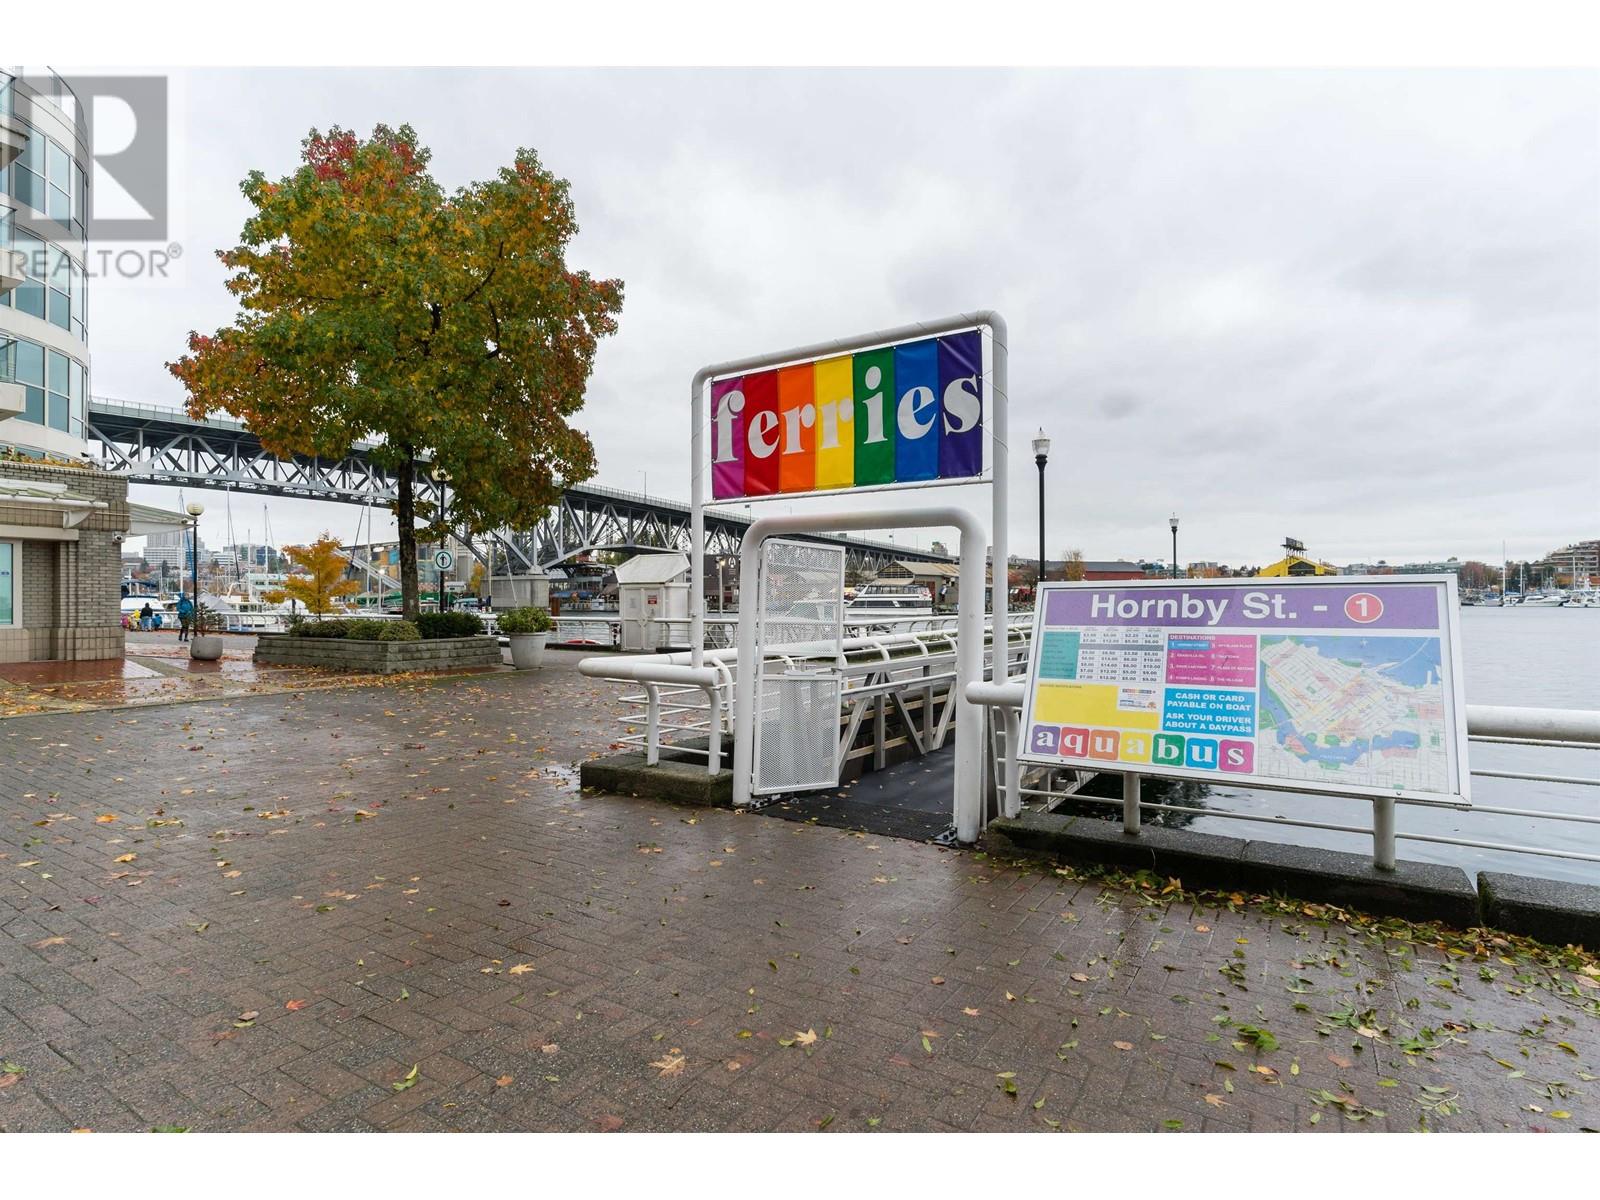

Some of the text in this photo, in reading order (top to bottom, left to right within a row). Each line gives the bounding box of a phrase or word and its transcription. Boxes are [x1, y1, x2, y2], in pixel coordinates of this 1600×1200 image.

[711, 366, 982, 463] ferries
[1090, 592, 1229, 626] Hornby
[1242, 592, 1298, 619] St.
[1354, 597, 1369, 617] 1
[1175, 692, 1245, 703] CASH OR CARD
[1167, 700, 1207, 709] PAYABLE
[1225, 703, 1252, 711] BOAT
[1166, 712, 1252, 724] ASK YOUR DRIVER
[1165, 721, 1197, 729] ABOUT
[1208, 723, 1252, 733] DAYPASS
[1035, 729, 1246, 767] aquabus
